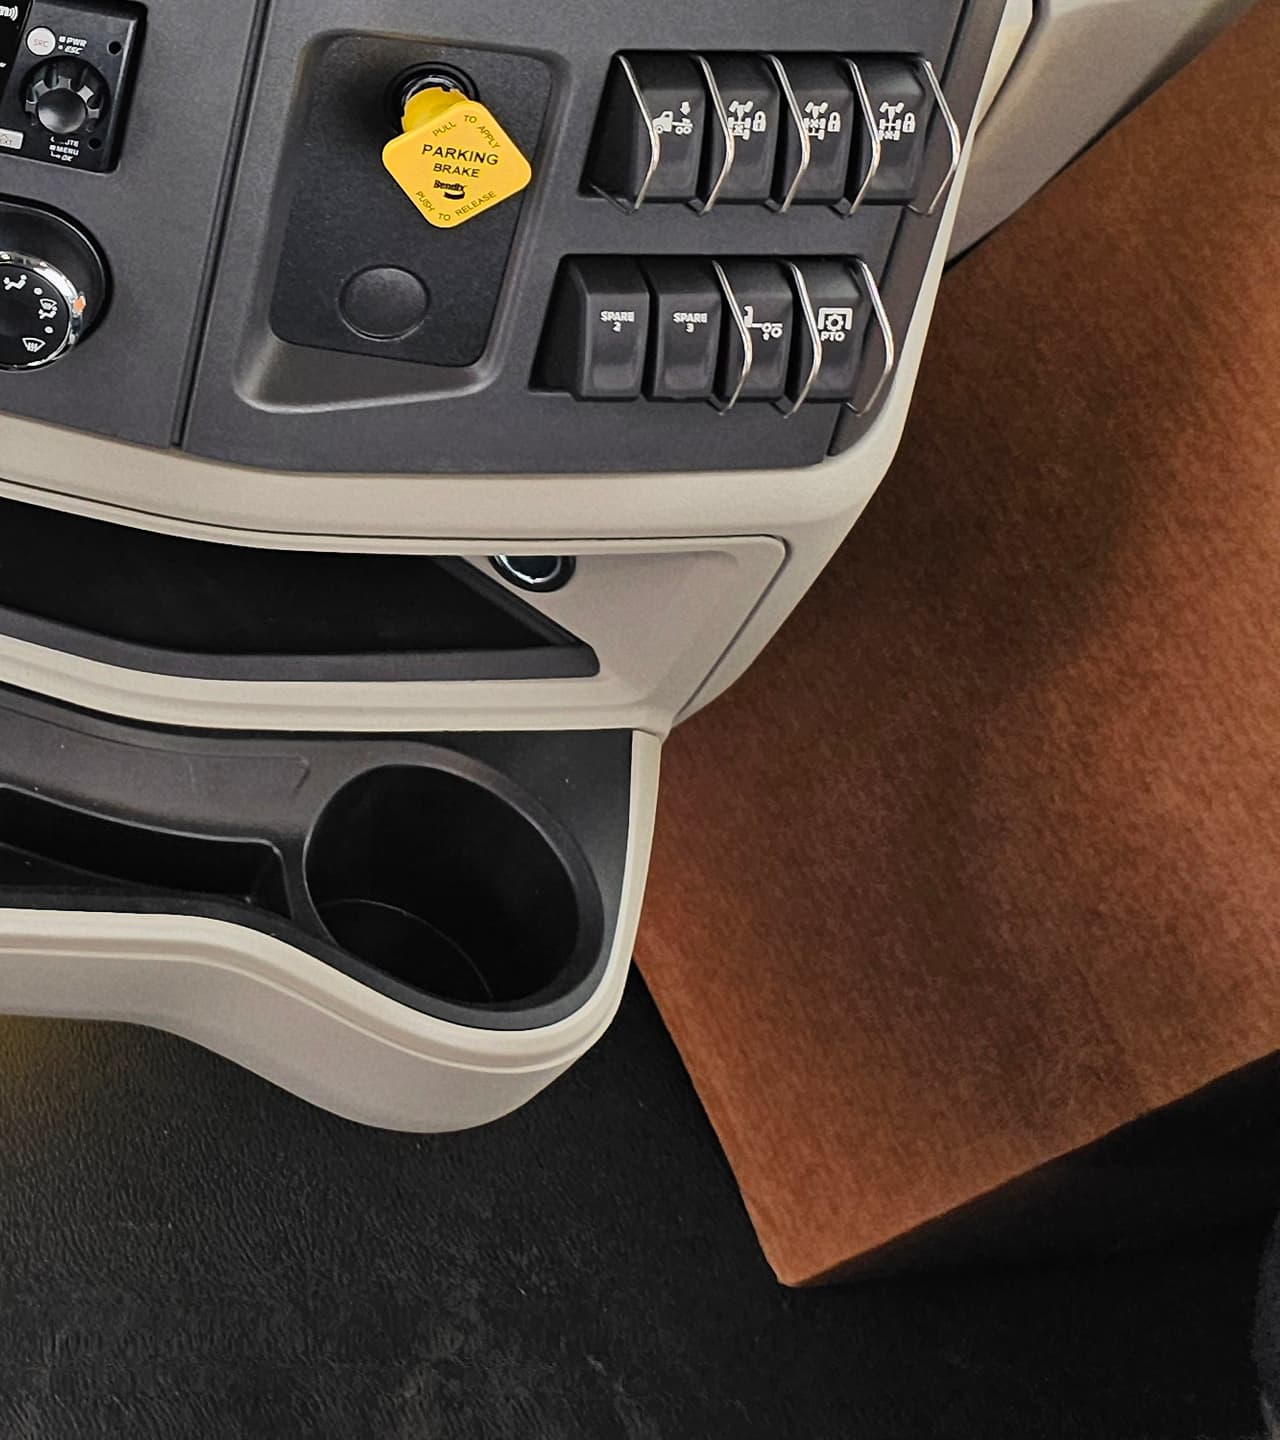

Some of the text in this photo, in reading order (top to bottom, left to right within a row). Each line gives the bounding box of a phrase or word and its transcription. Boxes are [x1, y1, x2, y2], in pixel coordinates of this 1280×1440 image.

[464, 114, 477, 124] TO
[432, 121, 456, 137] PULL
[478, 125, 500, 149] APPLY
[421, 144, 499, 166] PARKING
[433, 163, 480, 178] BRAKE
[416, 191, 496, 221] PUSH TO RELEASE
[600, 311, 635, 323] SPARE
[673, 312, 708, 324] SPARE
[613, 322, 621, 332] 2
[686, 322, 694, 333] 3
[821, 331, 845, 342] PTO
